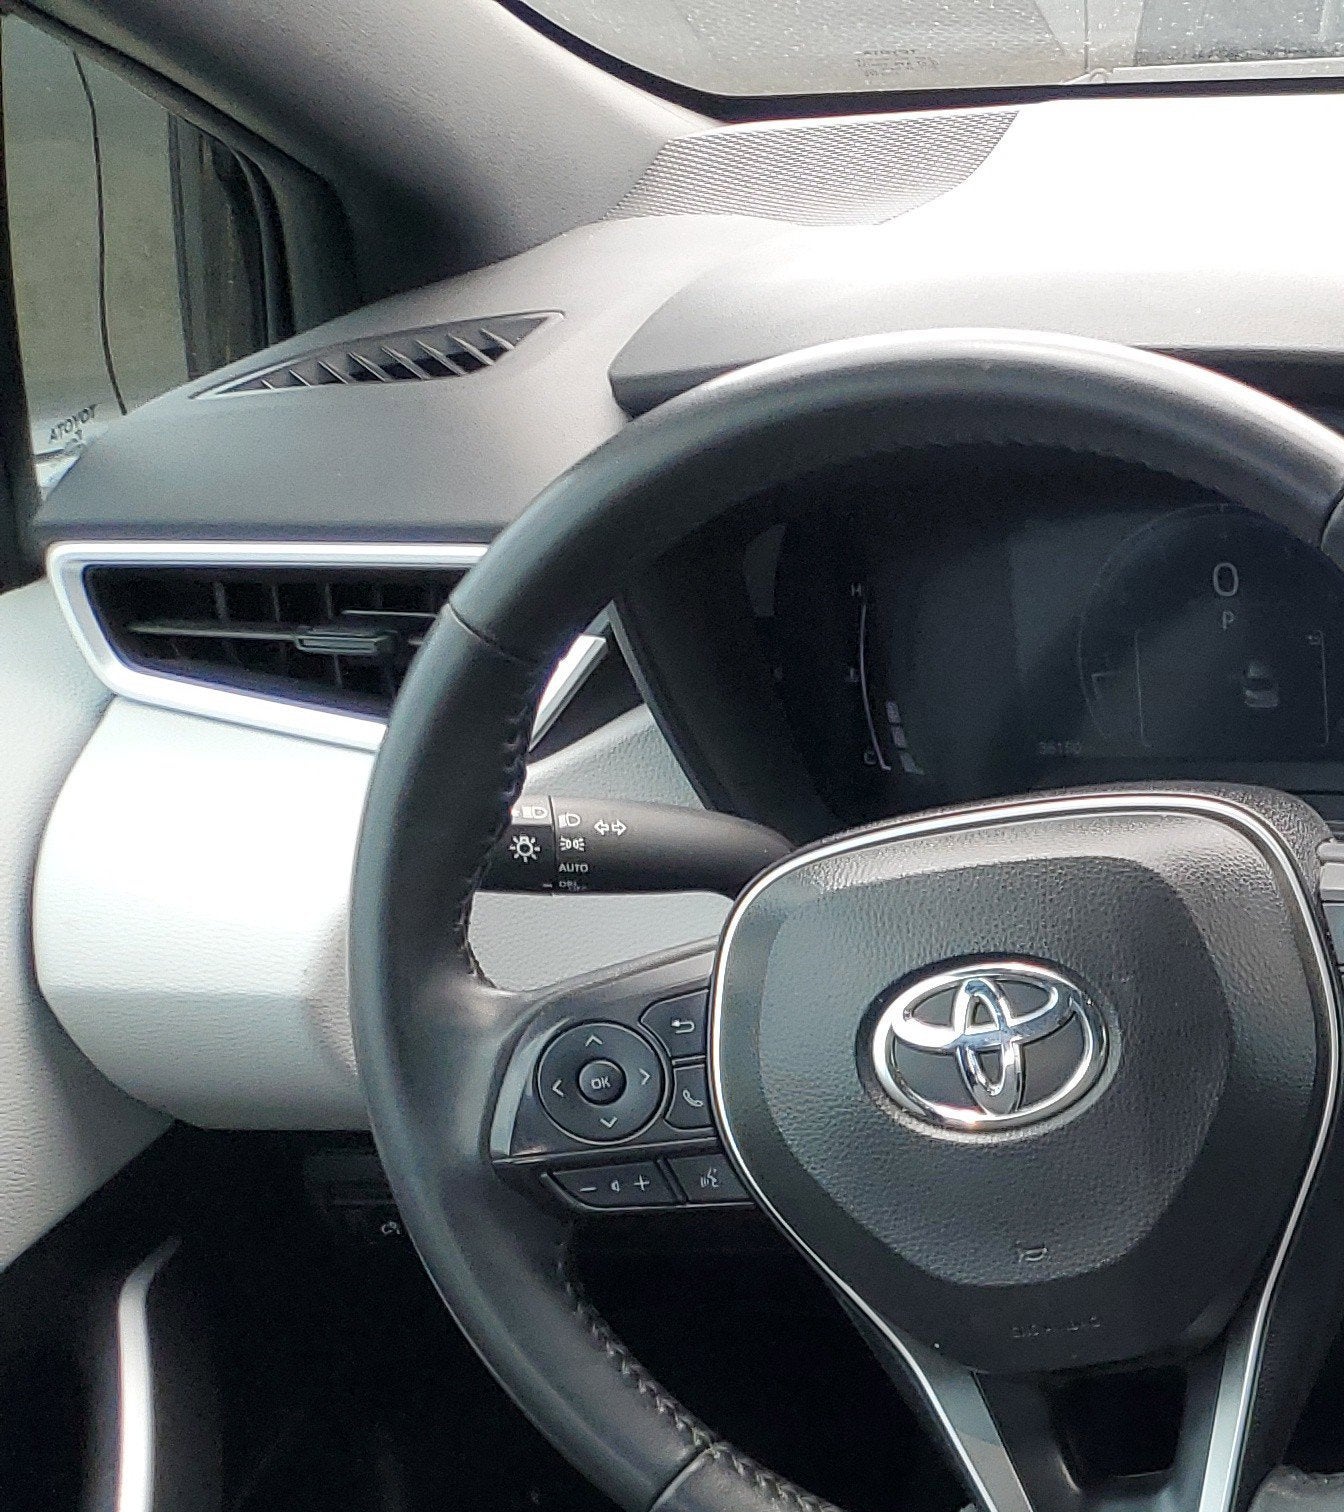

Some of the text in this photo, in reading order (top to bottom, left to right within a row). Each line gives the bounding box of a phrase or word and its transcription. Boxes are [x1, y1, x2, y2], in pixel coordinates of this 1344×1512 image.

[1222, 610, 1235, 631] P
[558, 863, 589, 873] AUTO
[591, 1077, 611, 1090] OK
